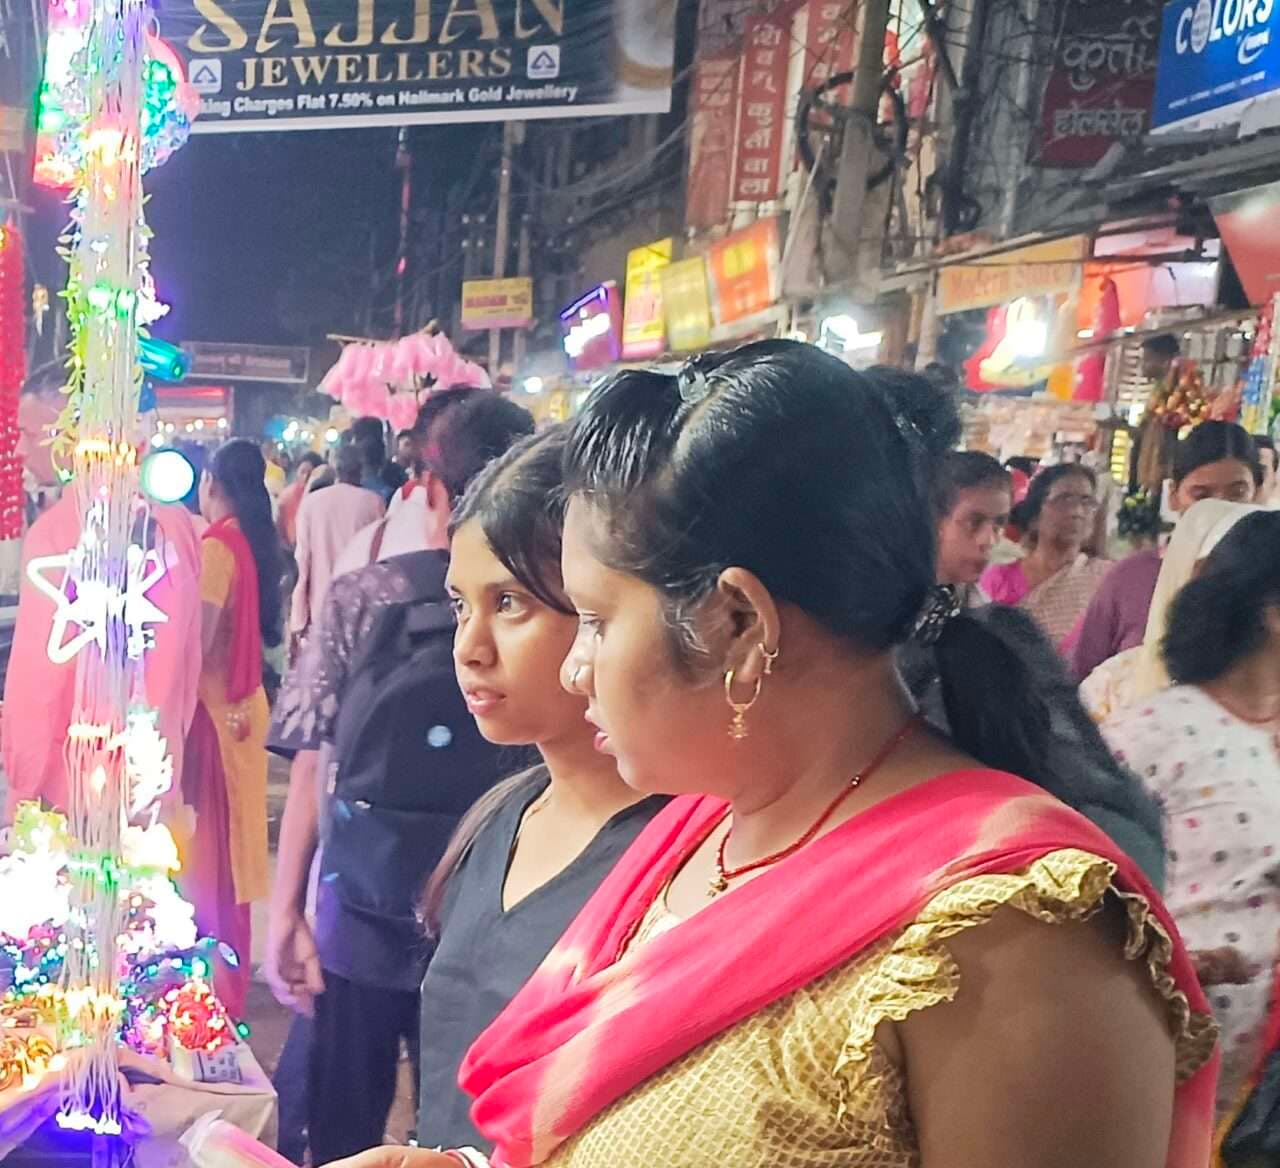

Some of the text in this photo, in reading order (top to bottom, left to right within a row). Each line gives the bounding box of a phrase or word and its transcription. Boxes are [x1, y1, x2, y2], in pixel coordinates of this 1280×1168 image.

[188, 0, 565, 53] SAJJAN
[236, 48, 513, 92] JEWELLERS
[233, 96, 294, 115] Charges
[297, 94, 326, 110] Flat
[376, 93, 395, 106] on
[398, 88, 465, 106] Hallmark
[468, 86, 503, 103] Gold
[506, 84, 578, 103] Jewellery
